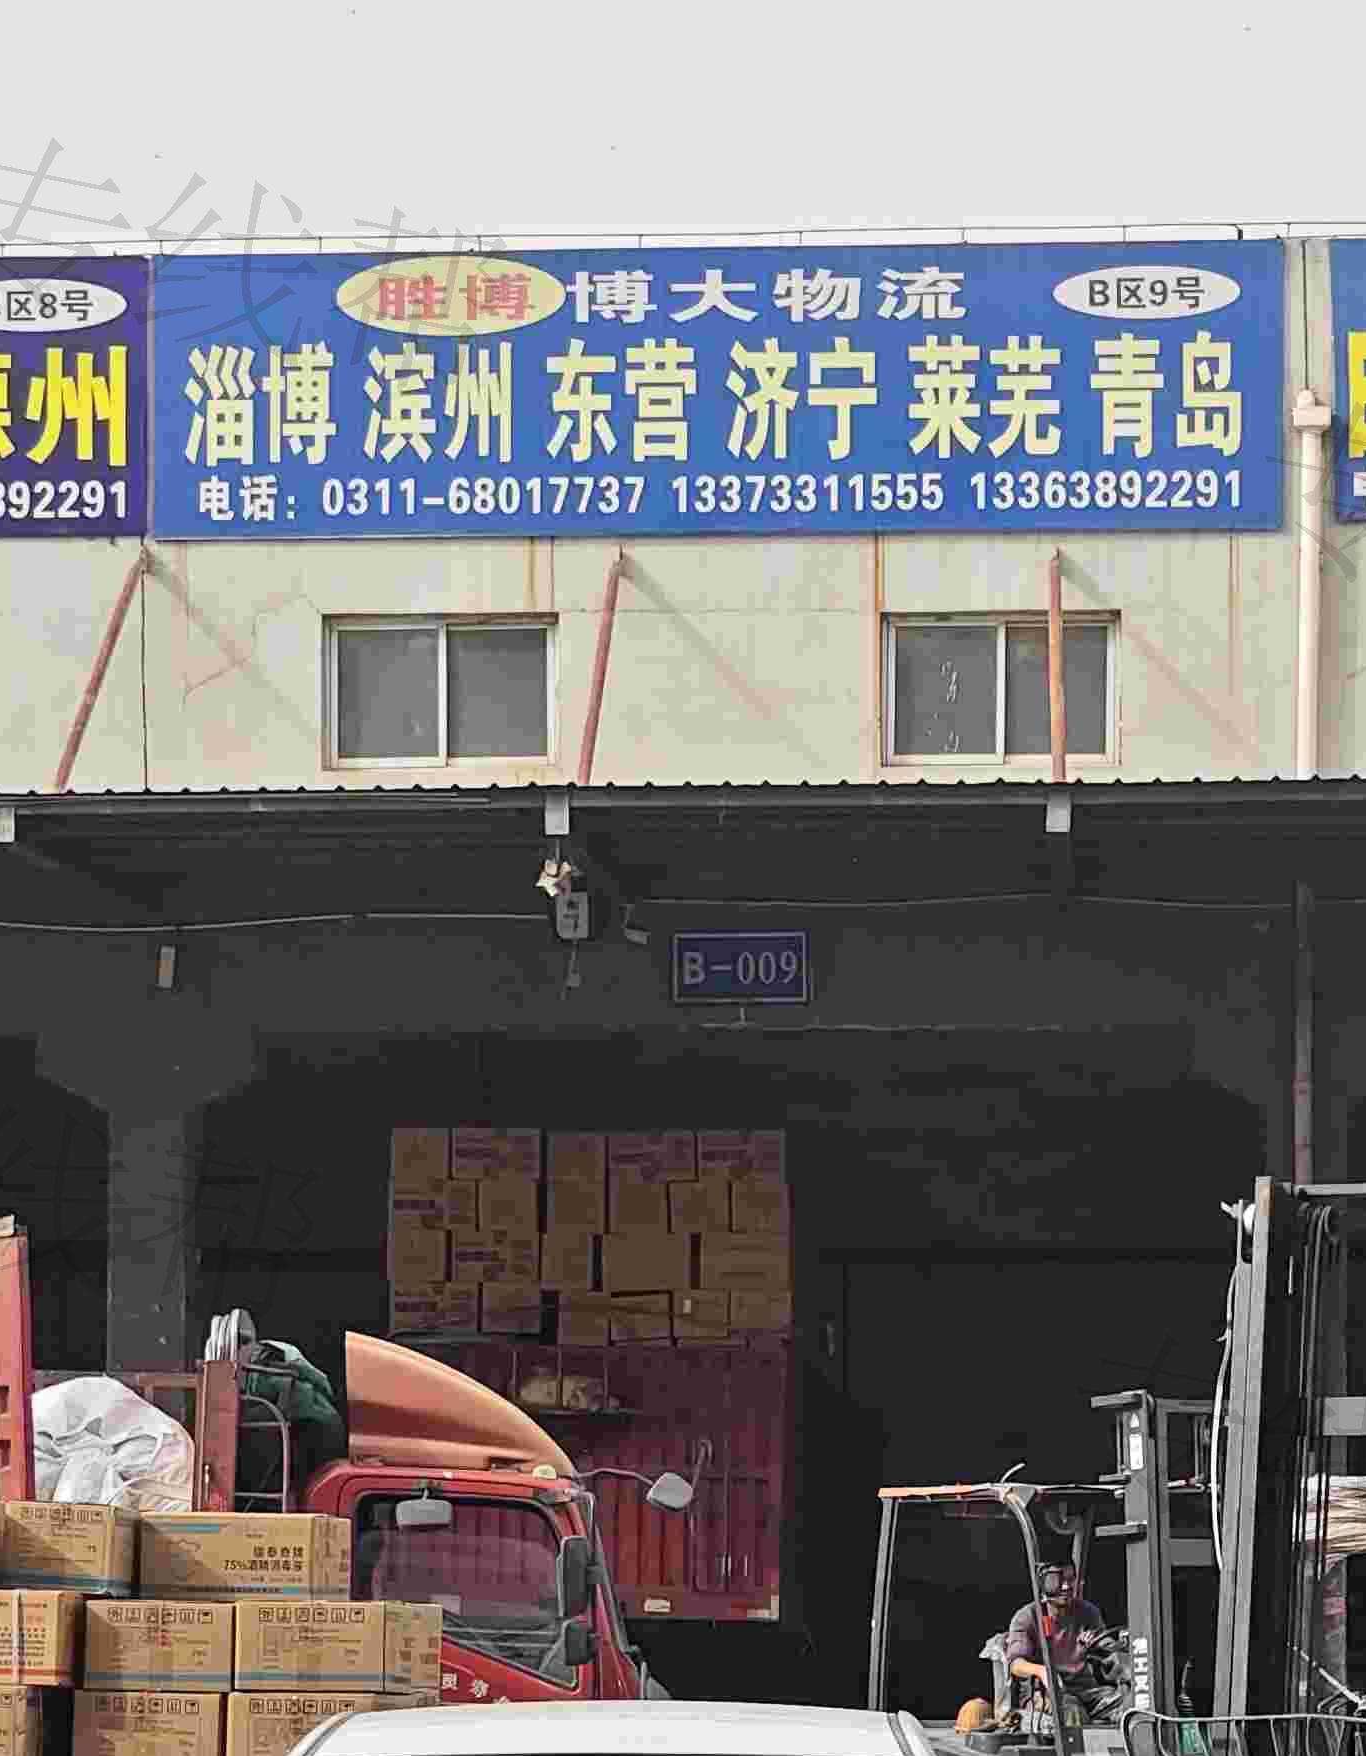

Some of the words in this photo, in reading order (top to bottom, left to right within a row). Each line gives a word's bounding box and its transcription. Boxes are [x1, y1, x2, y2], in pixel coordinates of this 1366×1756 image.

[375, 273, 537, 322] 胜博
[566, 267, 967, 323] 博大物流
[1087, 275, 1206, 310] B区9号
[183, 341, 337, 467] 淄博
[363, 341, 514, 466] 滨州
[545, 338, 699, 464] 东营
[724, 338, 878, 463] 济宁
[908, 335, 1063, 461] 莱芜
[1089, 330, 1243, 459] 青岛
[322, 475, 645, 517] 0311-68017737
[671, 472, 945, 515] 13373311555
[970, 469, 1244, 511] 13363892291
[685, 951, 798, 985] B-009
